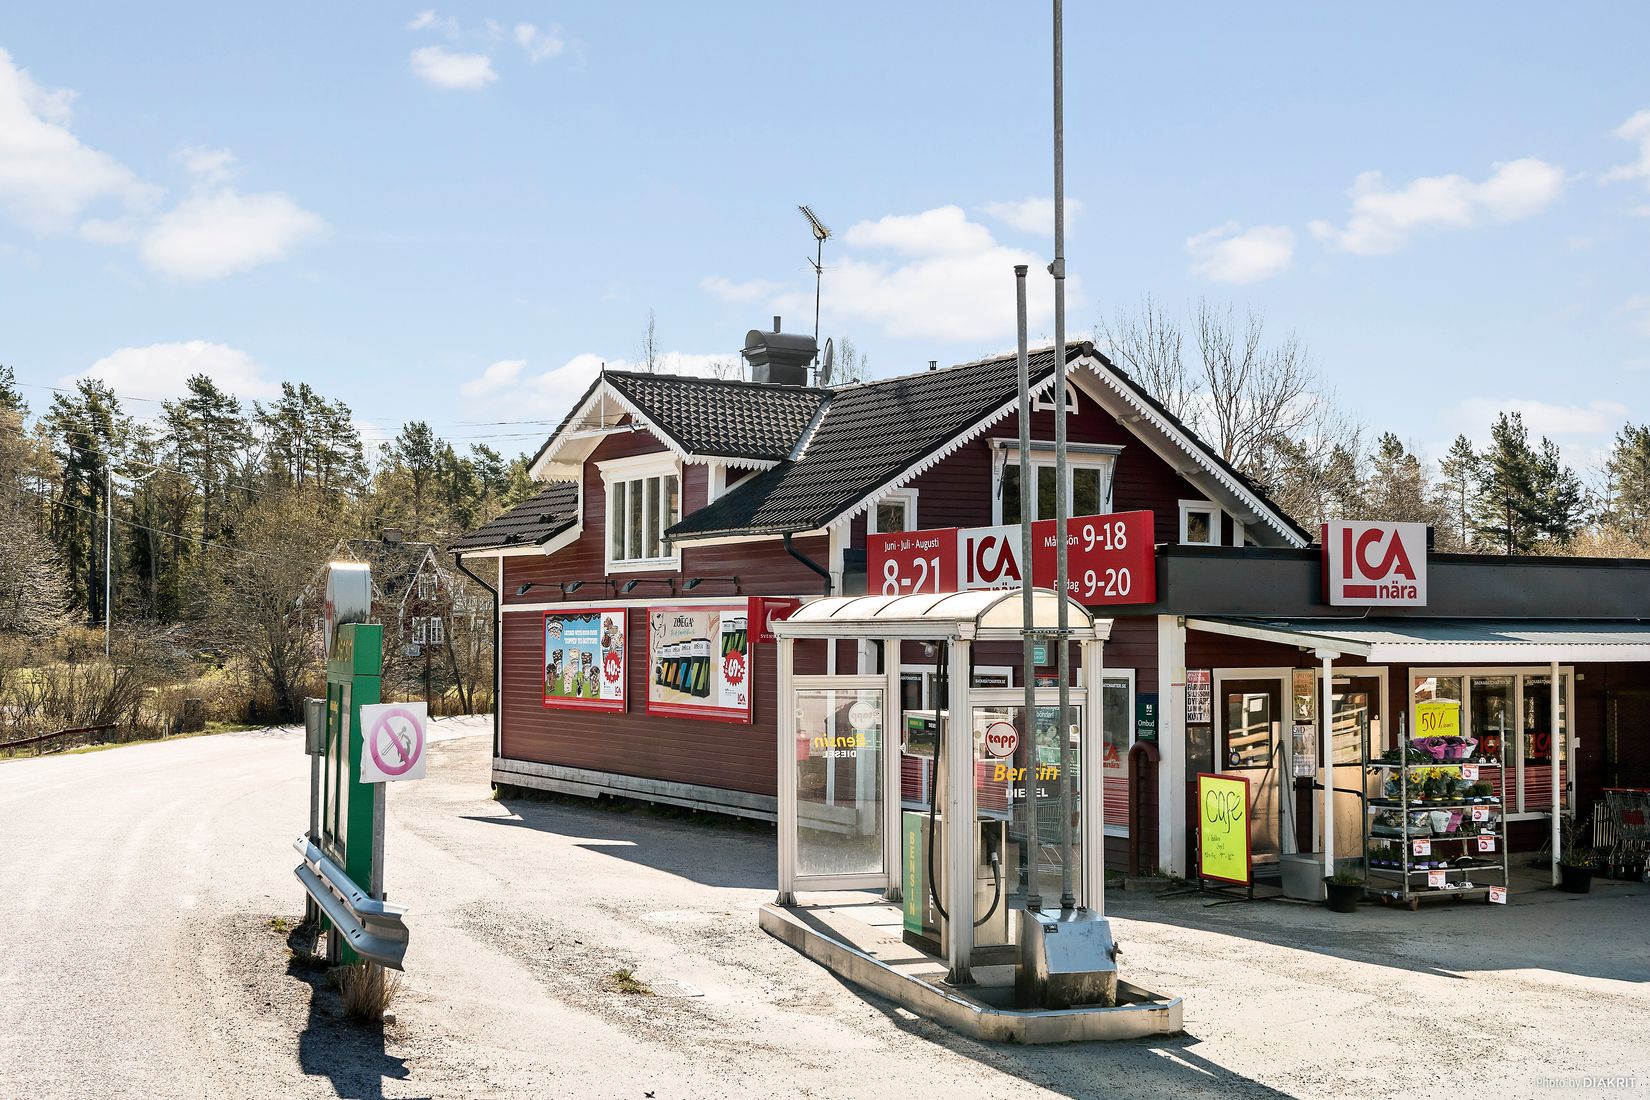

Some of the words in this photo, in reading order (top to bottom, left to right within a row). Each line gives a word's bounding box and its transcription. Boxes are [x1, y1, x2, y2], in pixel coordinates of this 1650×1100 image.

[884, 540, 896, 552] Juni
[900, 538, 911, 552] Juli
[915, 537, 940, 551] Augusti
[1082, 521, 1127, 553] 9-18
[966, 534, 1022, 583] ICA
[1342, 527, 1417, 581] ICA
[882, 556, 940, 596] 8-21
[1084, 567, 1131, 598] 9-20
[1379, 580, 1418, 600] nära
[1137, 719, 1155, 727] Ombud
[987, 734, 1016, 749] tapp
